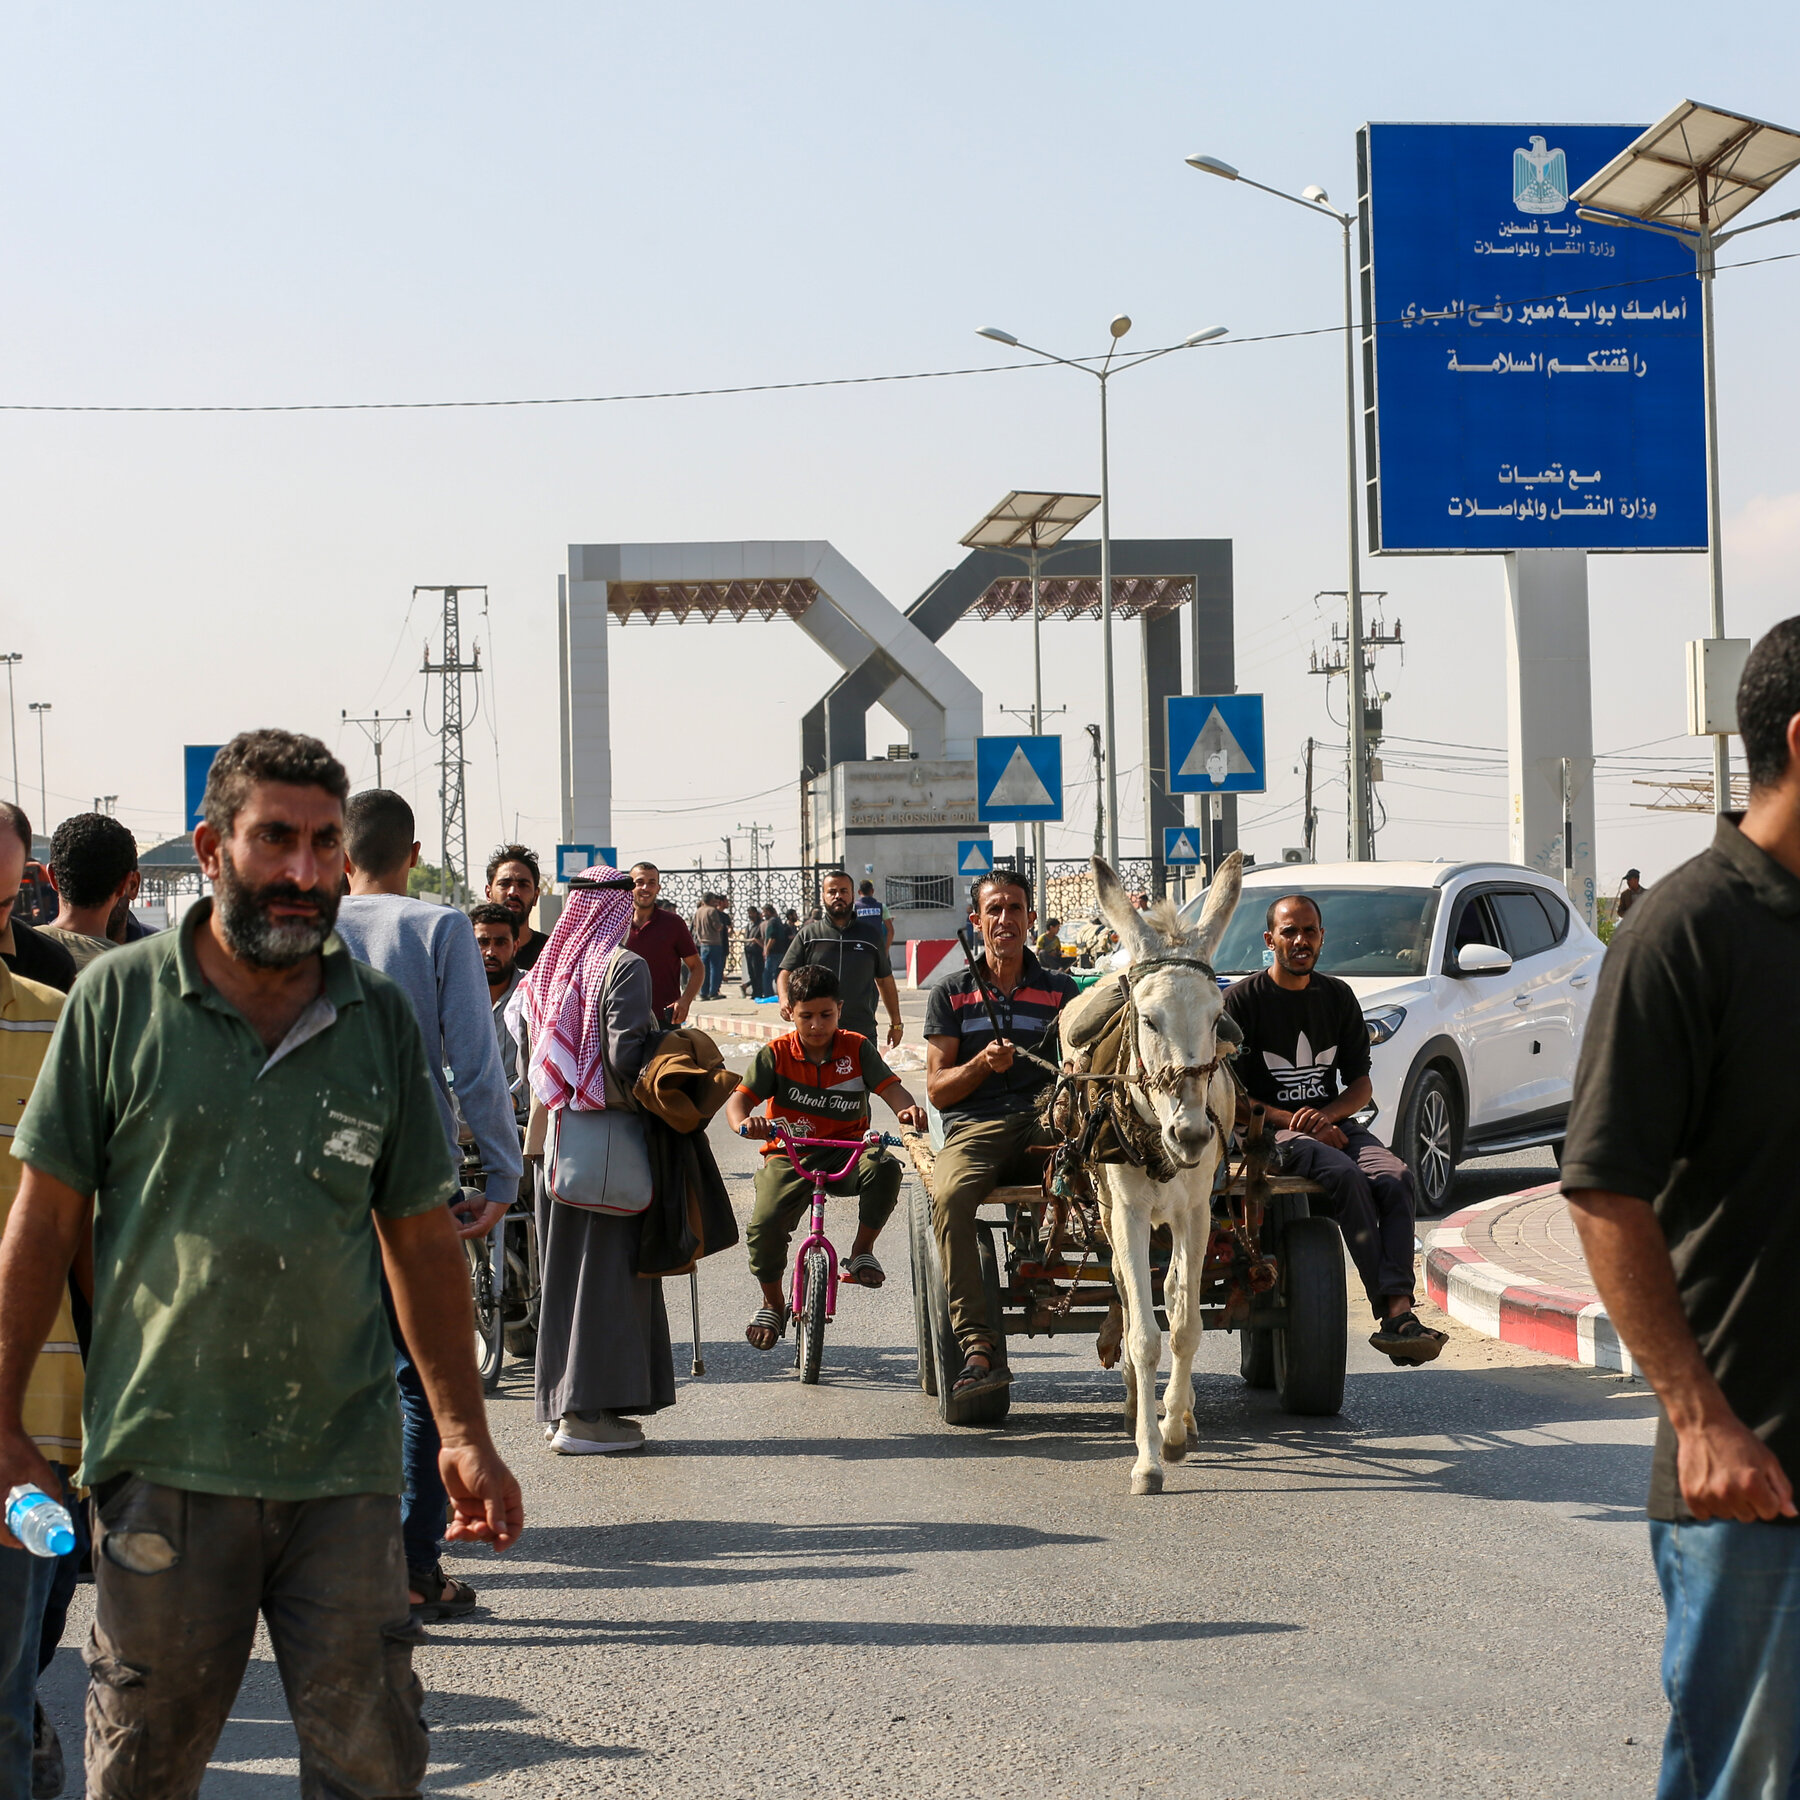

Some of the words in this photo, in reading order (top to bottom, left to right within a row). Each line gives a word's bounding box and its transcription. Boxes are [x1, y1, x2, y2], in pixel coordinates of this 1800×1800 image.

[1499, 218, 1539, 237] فلسطين
[1544, 219, 1582, 237] دولة
[1474, 240, 1540, 257] والمواصلات
[1545, 241, 1585, 257] النقل
[1589, 241, 1616, 257] وزارة
[1401, 299, 1464, 328] البري
[1467, 294, 1513, 327] رفح
[1516, 303, 1555, 326] معبر
[1557, 296, 1617, 327] بوابة
[1622, 296, 1687, 320] أمامك
[1447, 349, 1543, 374] السلامة
[1547, 348, 1647, 378] رافقتكم
[1498, 462, 1565, 491] تحيات
[1568, 469, 1602, 491] مع
[1447, 497, 1547, 521] والمواصلات
[1550, 494, 1614, 520] النقل
[1619, 497, 1658, 520] وزارة
[850, 814, 886, 825] RAFAH
[889, 811, 948, 823] CROSSING
[951, 811, 977, 822] POIN
[857, 908, 880, 917] PRESS
[788, 1087, 827, 1108] Detroit
[829, 1095, 860, 1112] Tigers
[1276, 1084, 1328, 1101] adida
